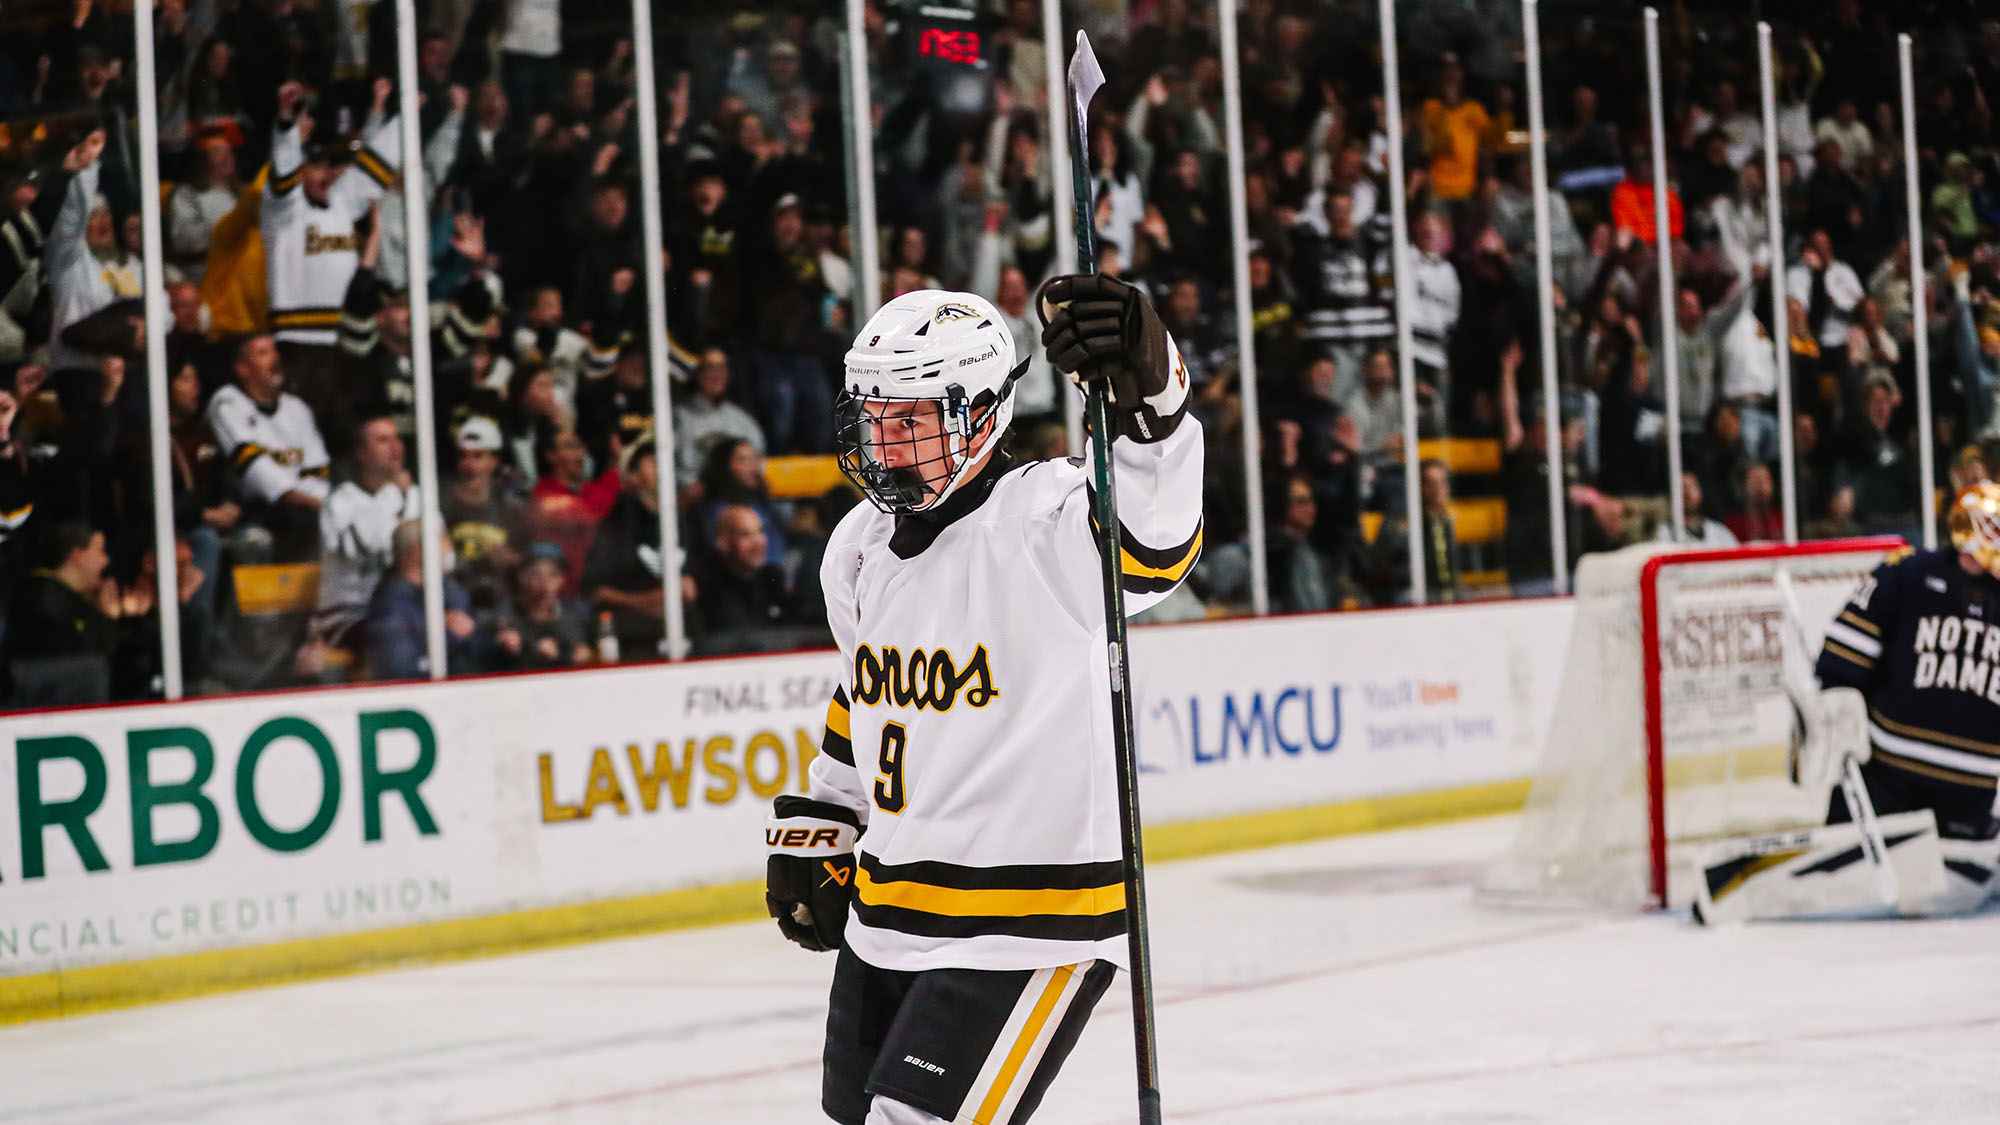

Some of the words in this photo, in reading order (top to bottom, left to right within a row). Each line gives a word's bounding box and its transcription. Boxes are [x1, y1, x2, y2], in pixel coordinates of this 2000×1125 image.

[869, 335, 881, 347] 9
[684, 681, 770, 715] FINAL
[851, 642, 999, 714] oncos
[1416, 680, 1462, 706] love
[1190, 684, 1343, 763] LMCU
[1367, 720, 1448, 751] banking
[873, 719, 908, 816] 9
[0, 709, 441, 883] RBOR
[150, 891, 302, 943] CREDIT
[323, 877, 455, 920] UNION
[904, 1054, 946, 1076] BAUER
